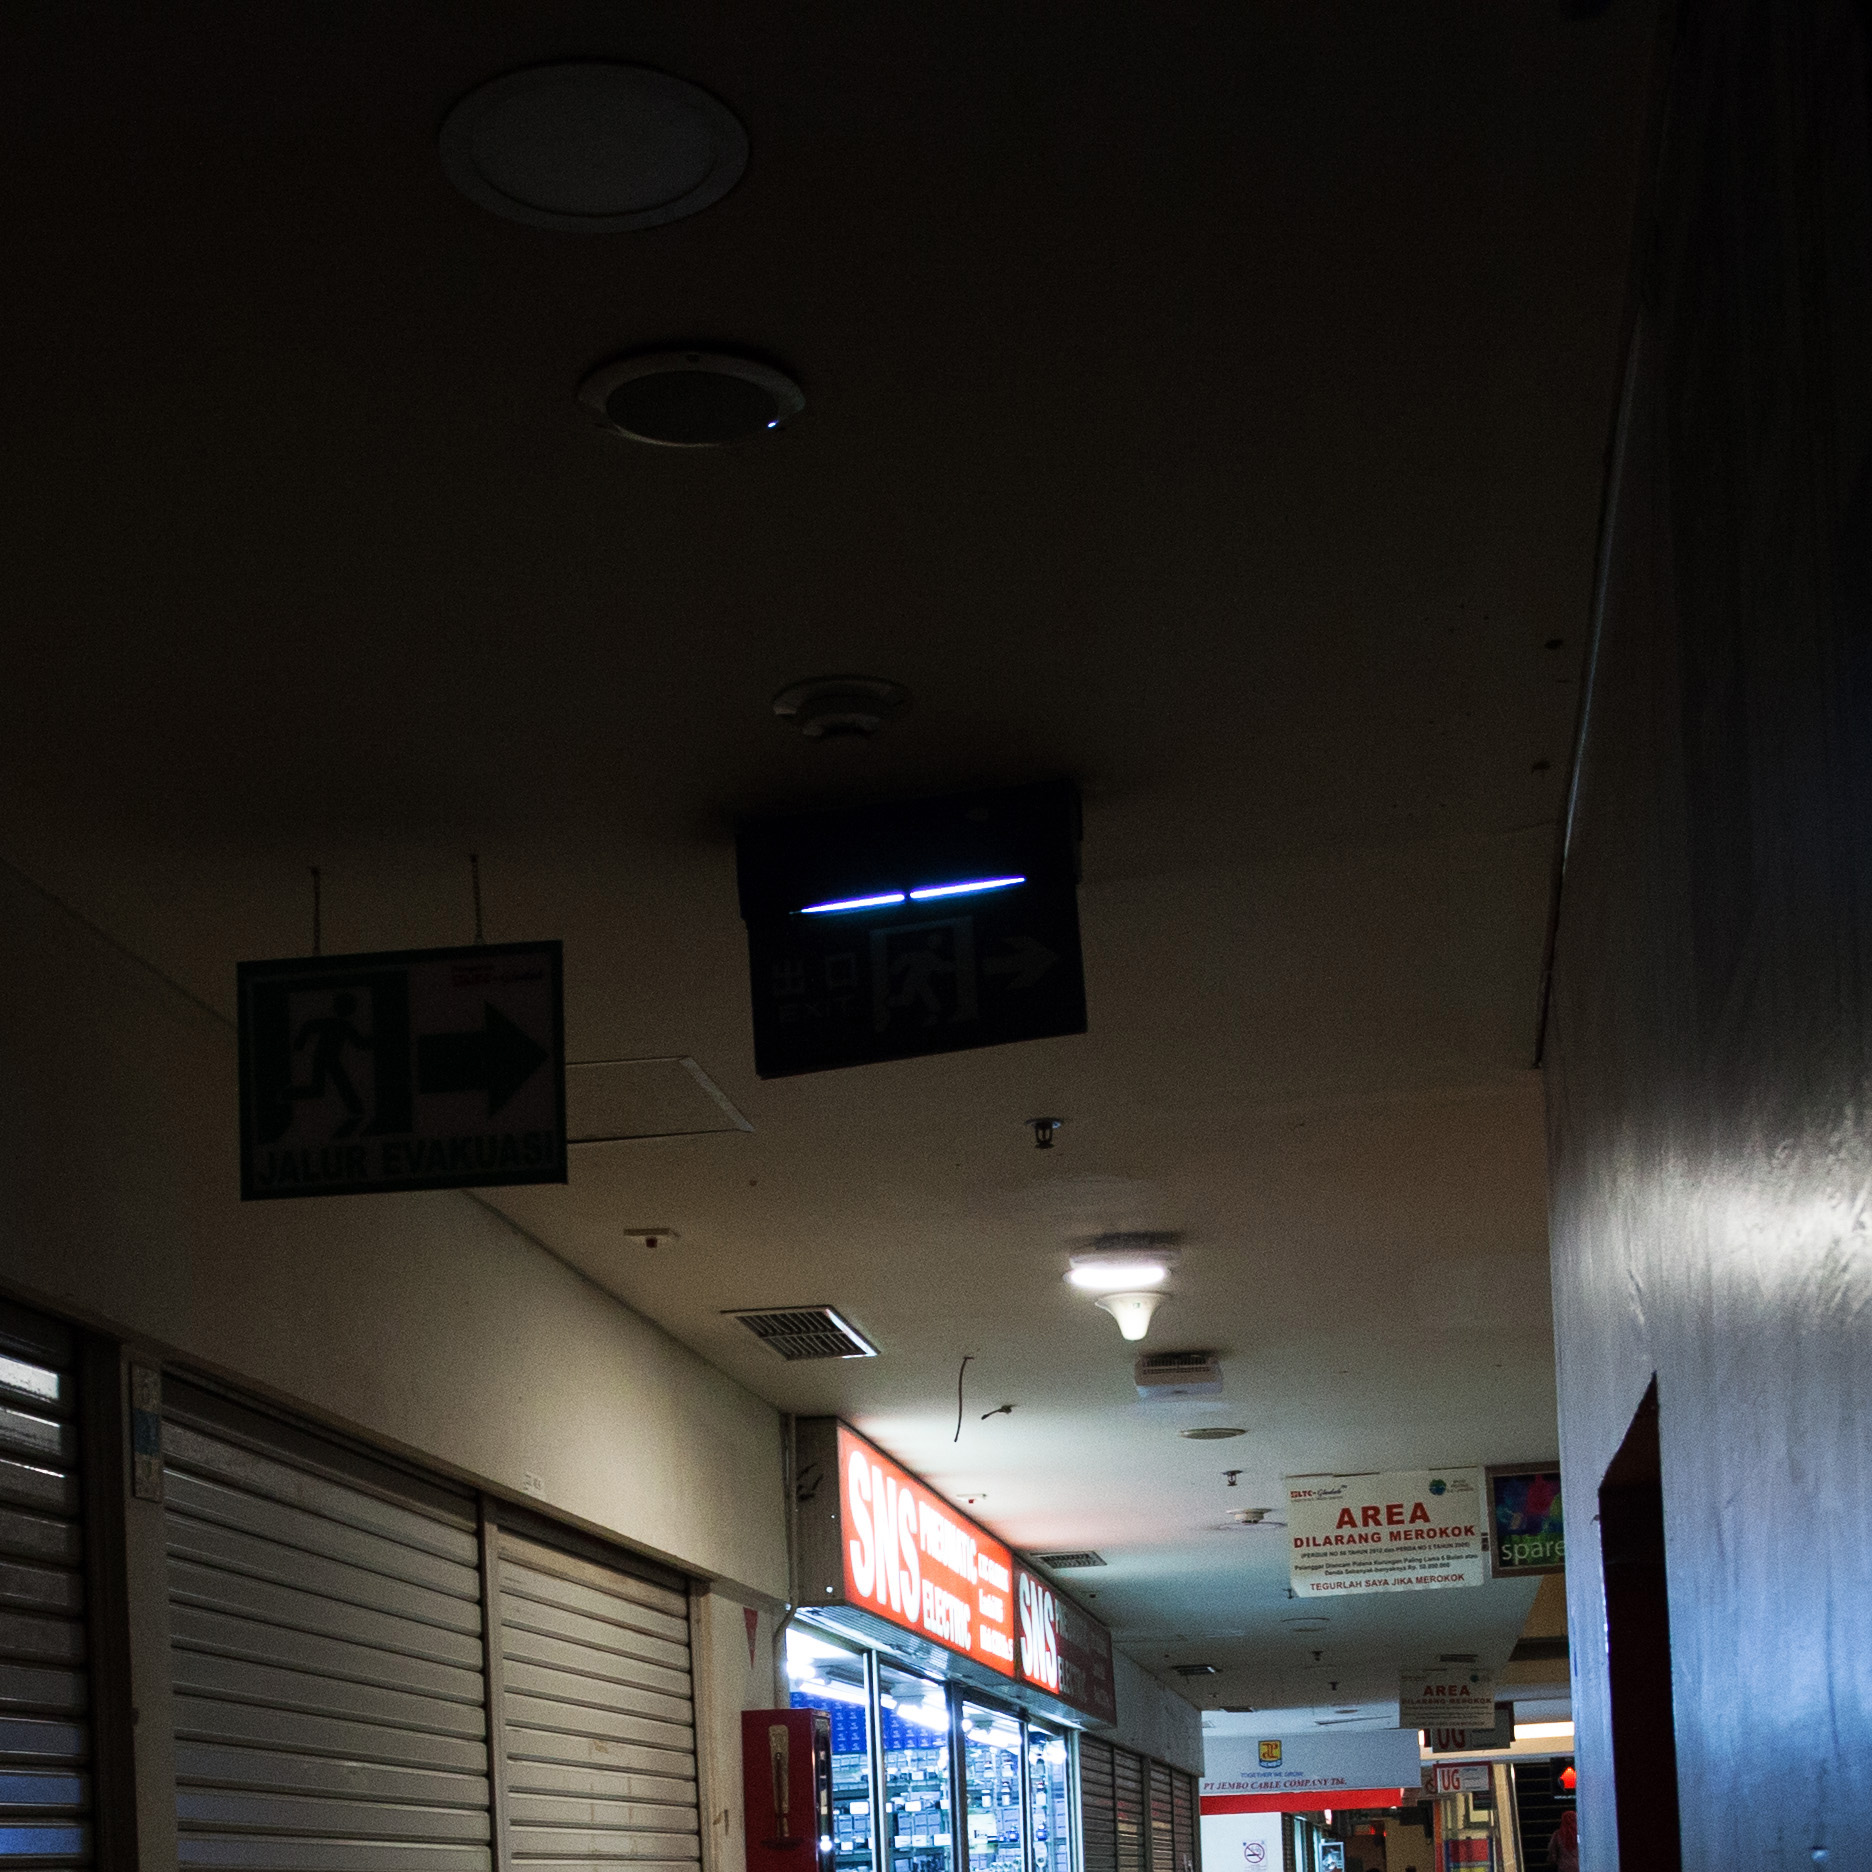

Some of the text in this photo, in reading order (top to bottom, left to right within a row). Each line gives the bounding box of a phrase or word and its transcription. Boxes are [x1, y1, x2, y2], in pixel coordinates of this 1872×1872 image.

[259, 1131, 554, 1187] JALUR EVAKUASI
[1336, 1502, 1431, 1529] AREA
[848, 1450, 921, 1624] SNS
[1294, 1525, 1475, 1548] DILARANG MEROKOK
[1310, 1573, 1465, 1591] TEGURLAH SAYA JIKA MEROKOK
[922, 1579, 972, 1652] ELECTRIC
[1019, 1572, 1058, 1690] SNS
[1423, 1685, 1470, 1696] AREA
[1438, 1728, 1465, 1749] UG
[1203, 1782, 1215, 1790] PT
[1216, 1781, 1249, 1790] JEMBO
[1250, 1780, 1280, 1789] CABLE
[1283, 1779, 1329, 1788] COMPANY
[1441, 1769, 1460, 1791] UG
